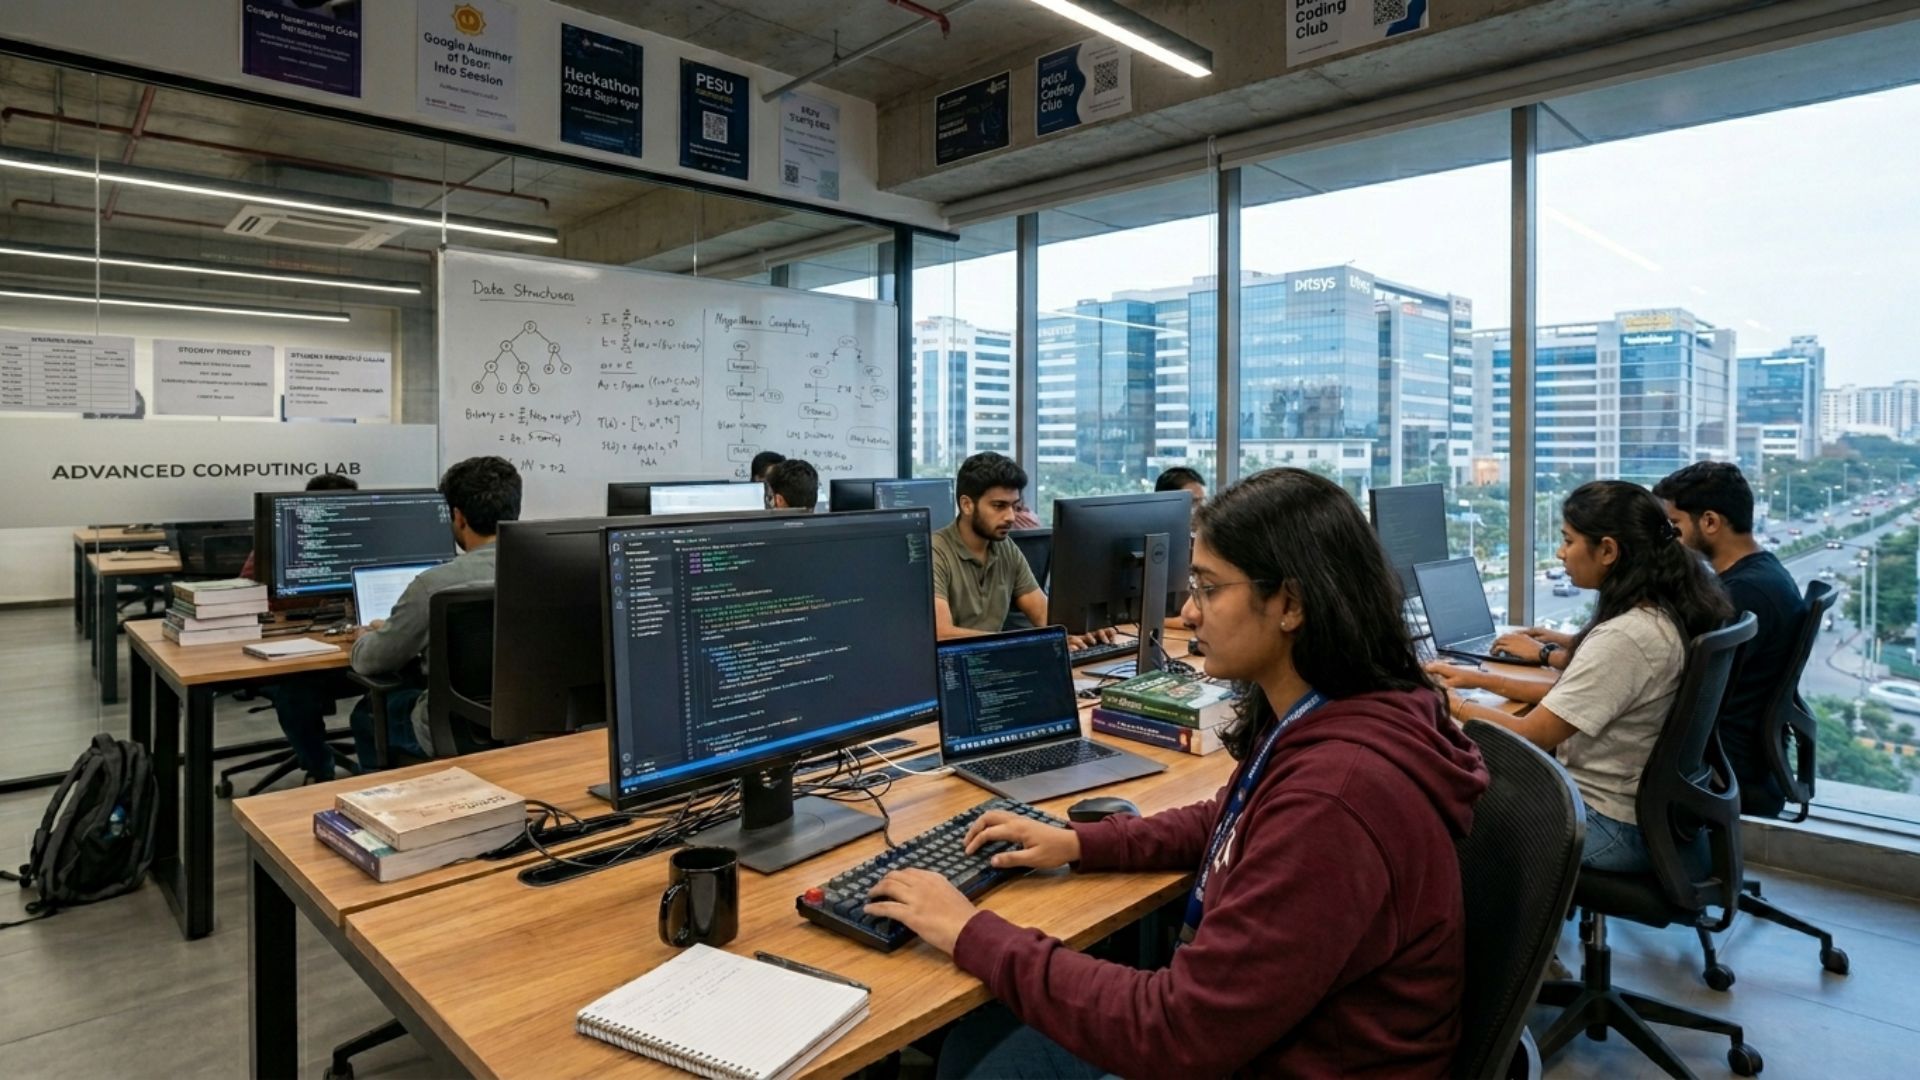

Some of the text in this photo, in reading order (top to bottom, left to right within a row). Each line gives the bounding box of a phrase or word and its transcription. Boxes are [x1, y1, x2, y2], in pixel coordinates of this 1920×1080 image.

[1296, 20, 1328, 39] Club
[696, 72, 734, 94] PESU
[51, 461, 361, 480] ADVANCED COMPUTING LAB
